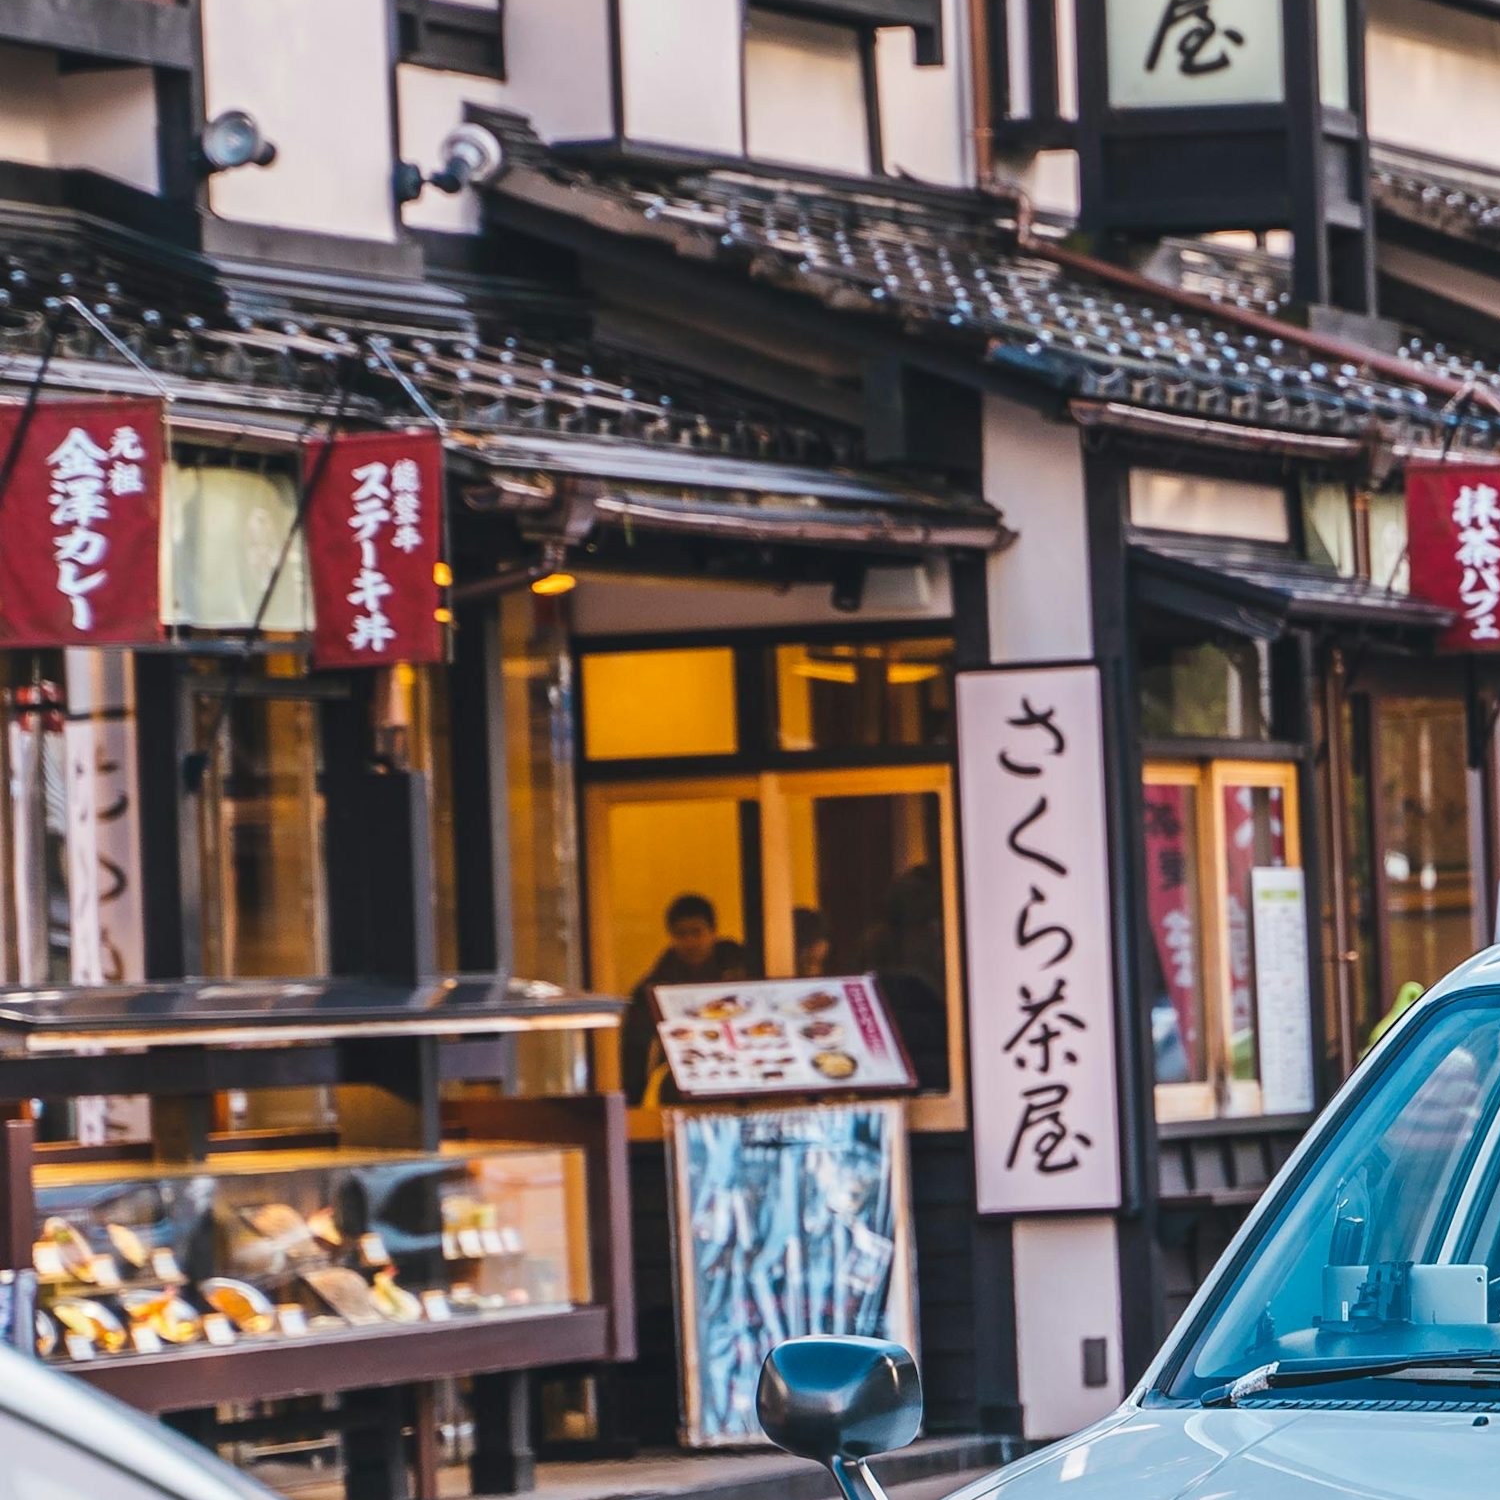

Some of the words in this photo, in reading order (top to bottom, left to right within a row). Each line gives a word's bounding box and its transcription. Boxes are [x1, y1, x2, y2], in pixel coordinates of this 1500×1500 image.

[45, 426, 111, 631] 金澤カレー
[108, 425, 147, 496] 元祖
[347, 460, 397, 653] ステーキ丼
[998, 696, 1096, 1176] さくら茶屋
